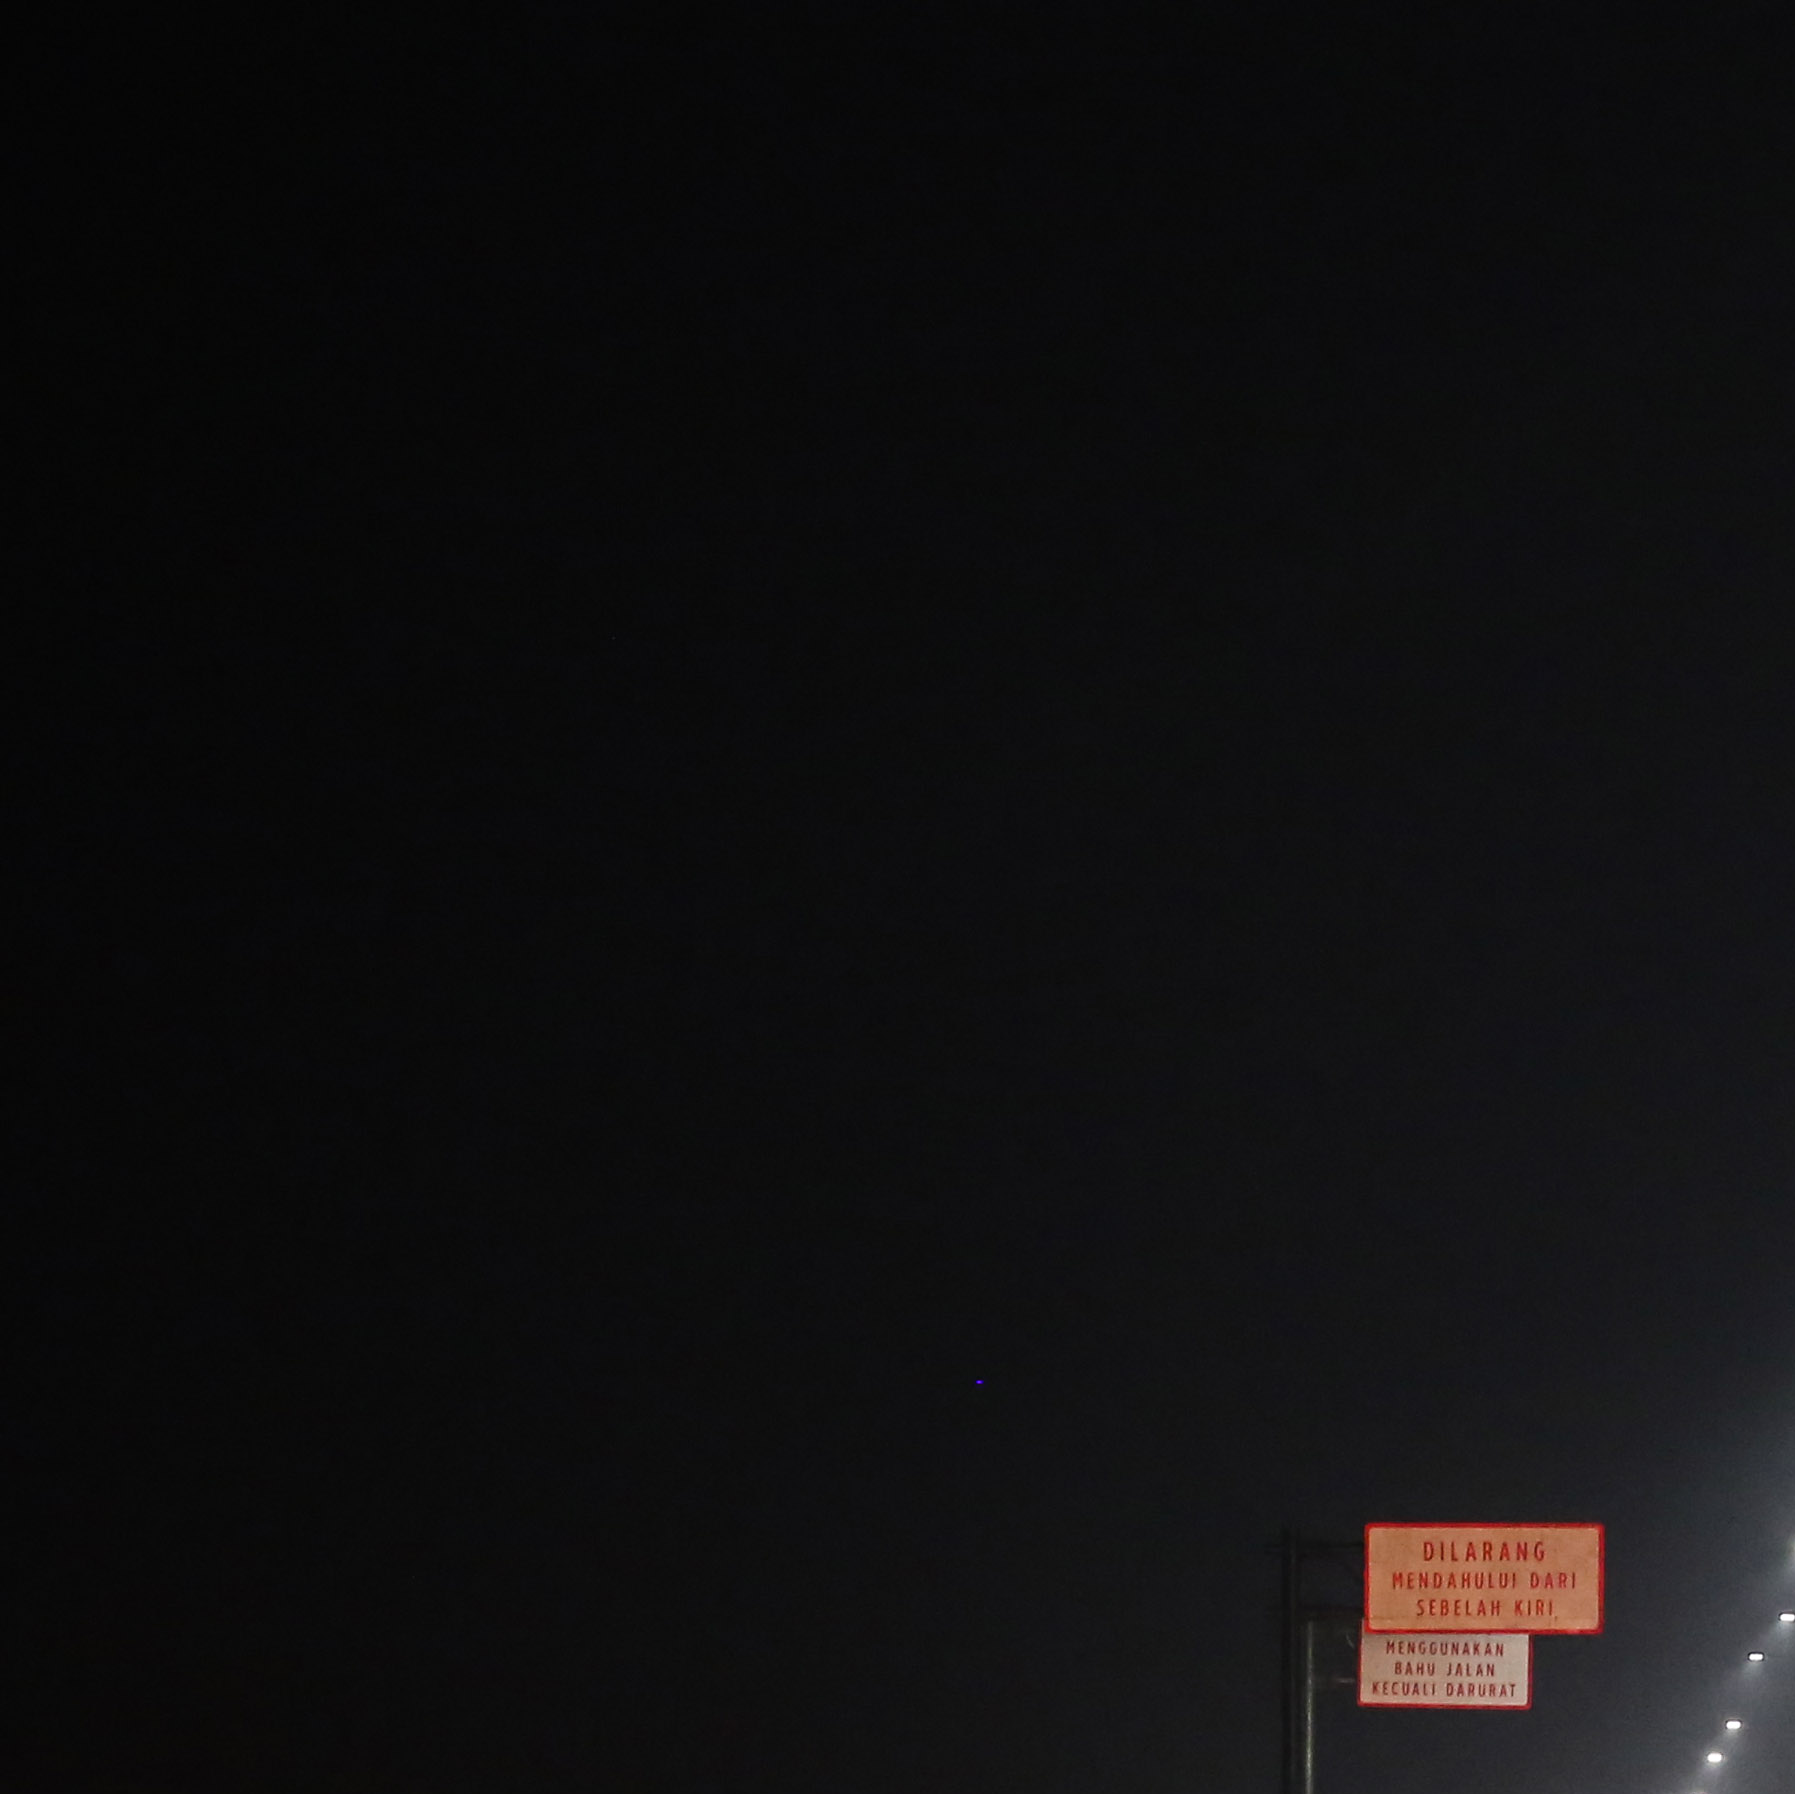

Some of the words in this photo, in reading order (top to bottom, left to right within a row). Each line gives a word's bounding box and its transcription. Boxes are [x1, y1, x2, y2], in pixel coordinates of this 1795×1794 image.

[1424, 1541, 1545, 1562] DILARANG
[1392, 1572, 1516, 1589] MENDAHULUI
[1530, 1572, 1575, 1589] DARI
[1417, 1599, 1500, 1616] SEBELAH
[1514, 1599, 1552, 1616] KIRI
[1385, 1639, 1503, 1656] MENGGUNAKAN
[1395, 1661, 1435, 1676] BAHU
[1447, 1663, 1494, 1676] JALAN
[1372, 1681, 1435, 1696] KECUALI
[1446, 1683, 1515, 1697] DARURAT
